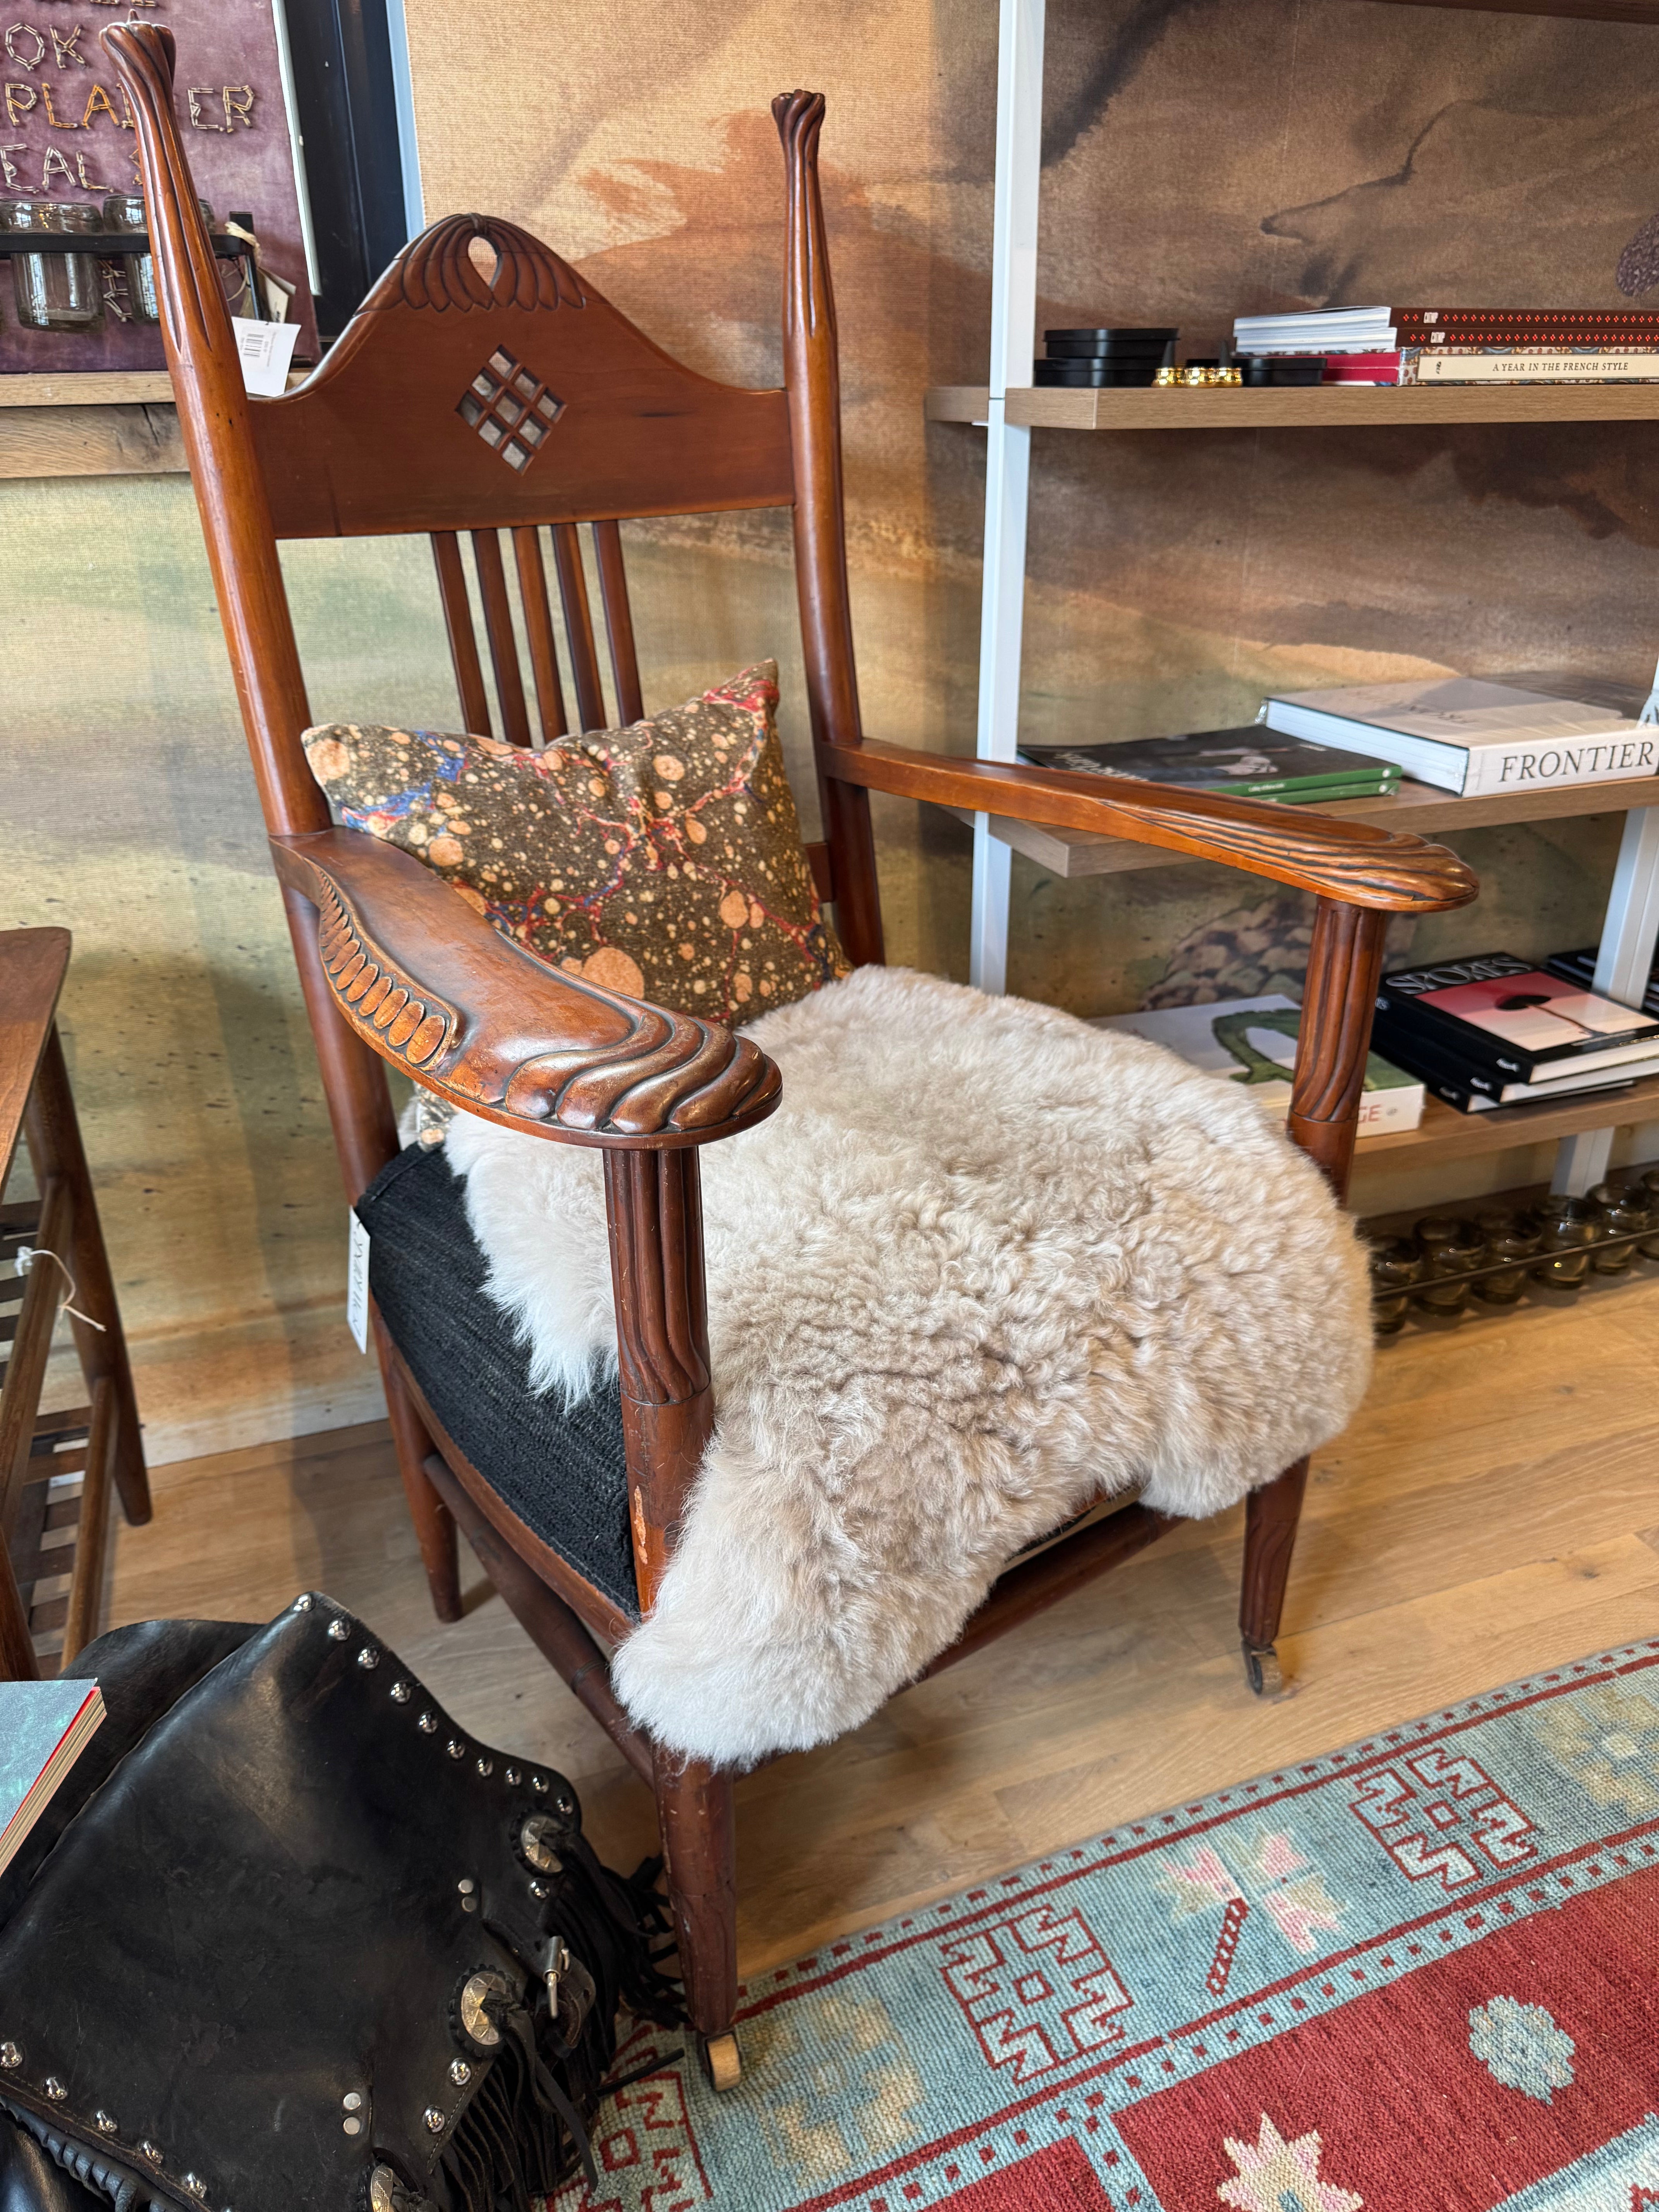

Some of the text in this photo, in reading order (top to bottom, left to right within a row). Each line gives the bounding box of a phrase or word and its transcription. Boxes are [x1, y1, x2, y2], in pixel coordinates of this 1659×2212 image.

[4, 82, 256, 134] PLAER
[1528, 362, 1539, 371] IN
[1541, 362, 1560, 371] THE
[1563, 362, 1599, 371] FRENCH
[1601, 362, 1629, 371] STYLE
[1498, 741, 1654, 782] FRONTIER
